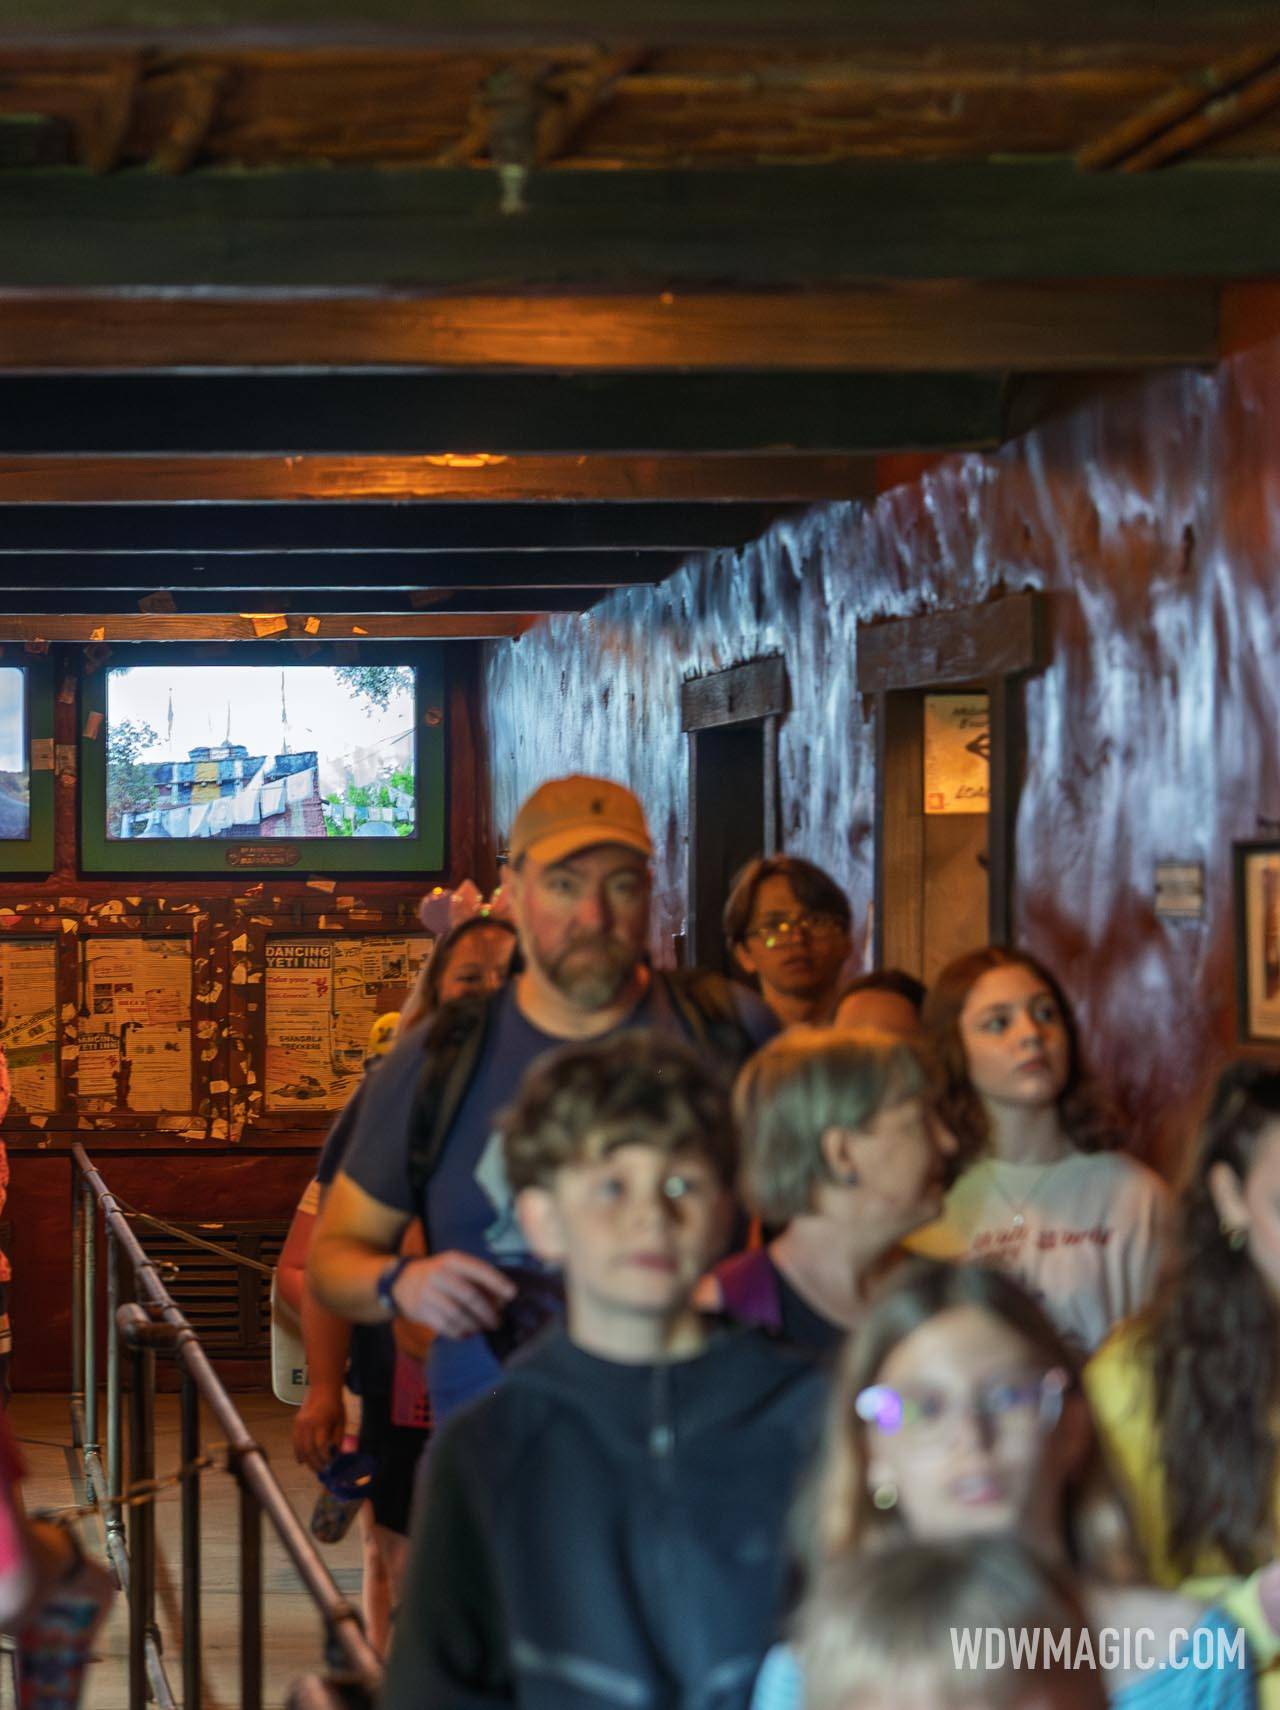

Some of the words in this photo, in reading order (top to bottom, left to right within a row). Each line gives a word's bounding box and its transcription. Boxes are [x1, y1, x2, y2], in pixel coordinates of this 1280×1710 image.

[265, 946, 330, 957] DANCING
[265, 957, 299, 968] YETI
[303, 957, 329, 968] INN
